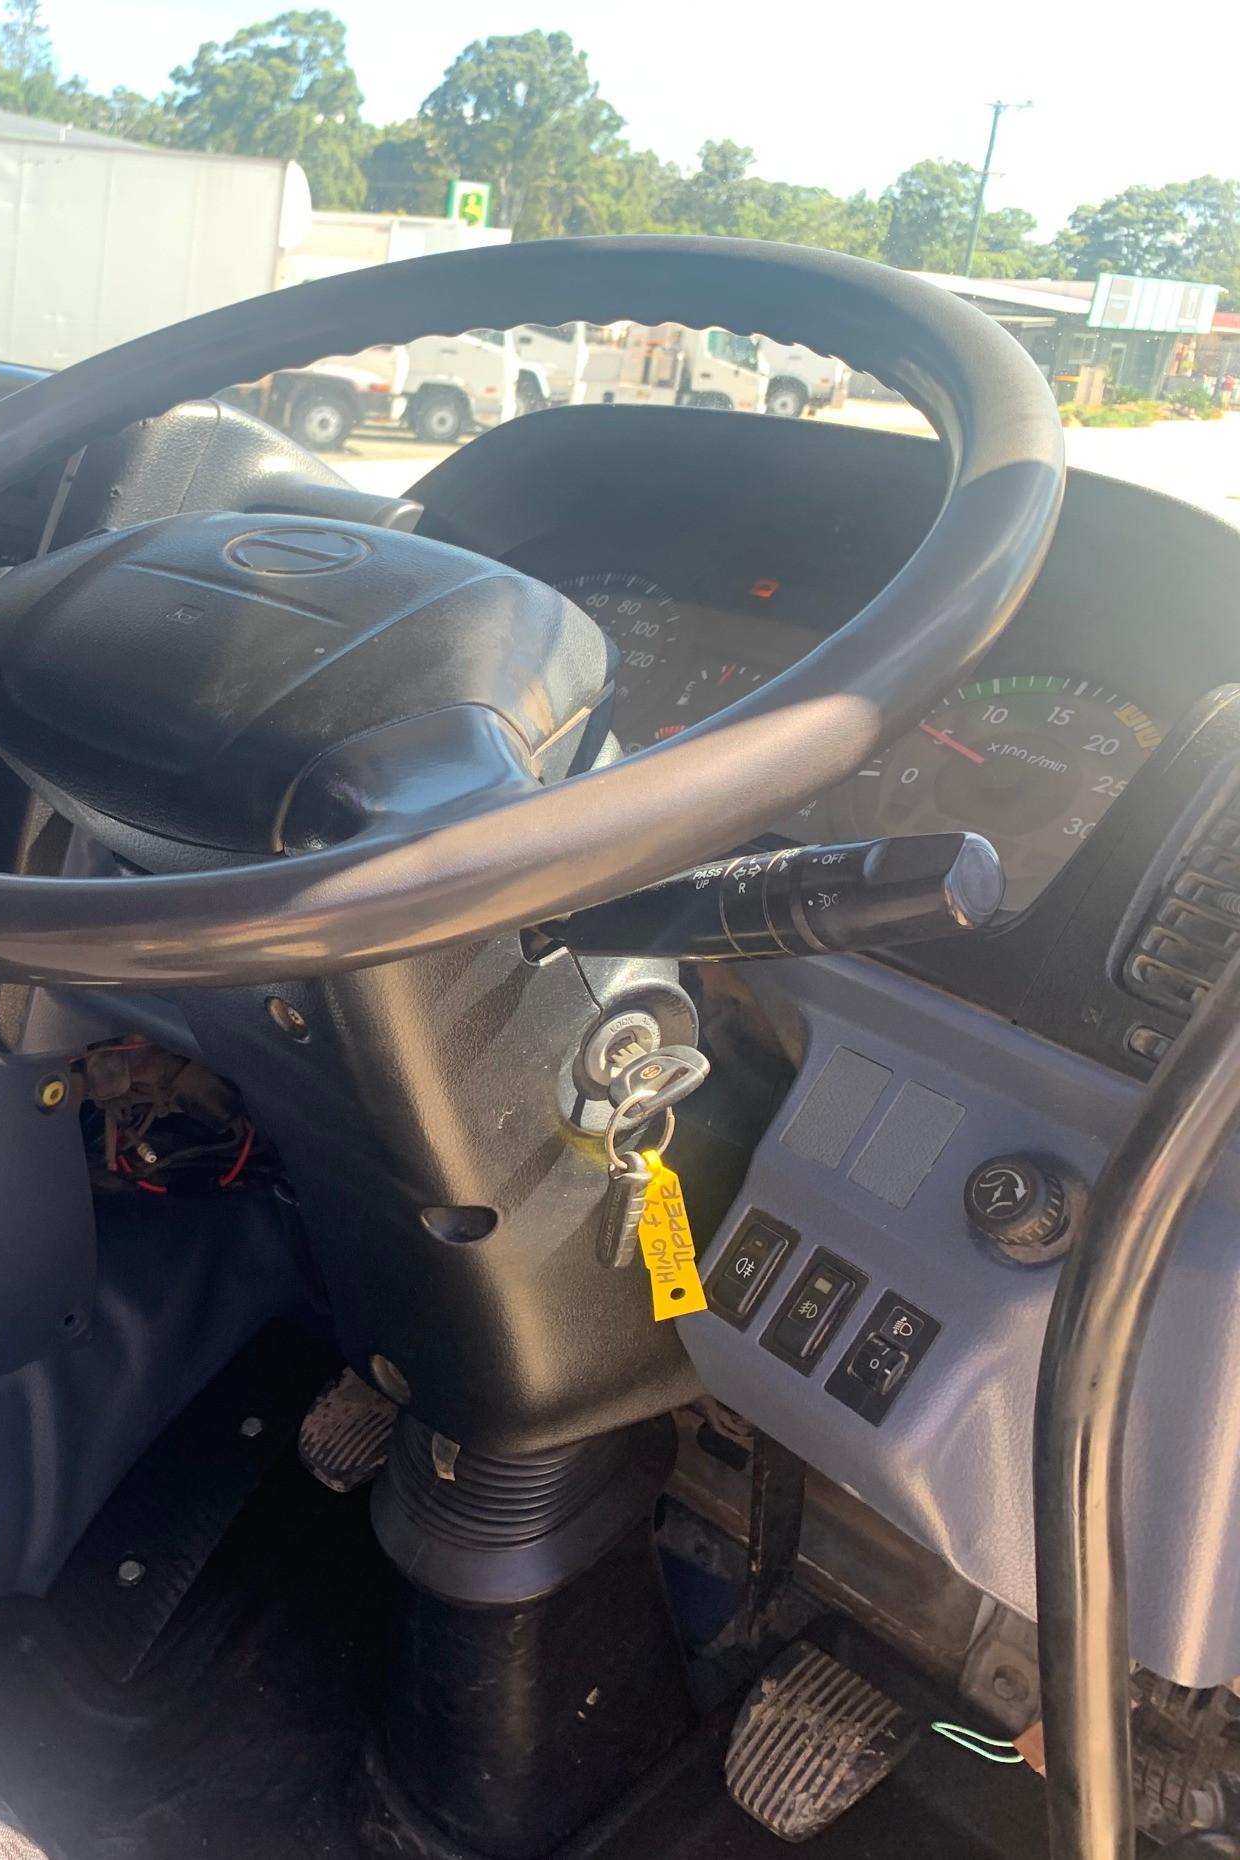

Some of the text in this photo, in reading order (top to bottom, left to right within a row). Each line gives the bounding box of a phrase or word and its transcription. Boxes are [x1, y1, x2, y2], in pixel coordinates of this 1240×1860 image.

[585, 592, 610, 609] 60
[616, 599, 642, 616] 80
[629, 619, 660, 639] 100
[624, 650, 655, 669] 120
[981, 704, 1009, 725] 10
[1047, 705, 1075, 727] 15
[932, 728, 954, 746] 5
[1082, 734, 1120, 757] 20
[1026, 753, 1069, 775] r/min
[899, 767, 920, 785] 0
[1091, 775, 1129, 798] 25
[1063, 818, 1096, 840] 30
[821, 852, 848, 865] OFF
[692, 867, 724, 880] PASS
[695, 878, 710, 890] UP
[738, 882, 747, 894] R
[609, 1015, 634, 1034] LOCK
[659, 1180, 694, 1272] TIPPER
[648, 1239, 676, 1283] HINO
[869, 1358, 880, 1370] 0
